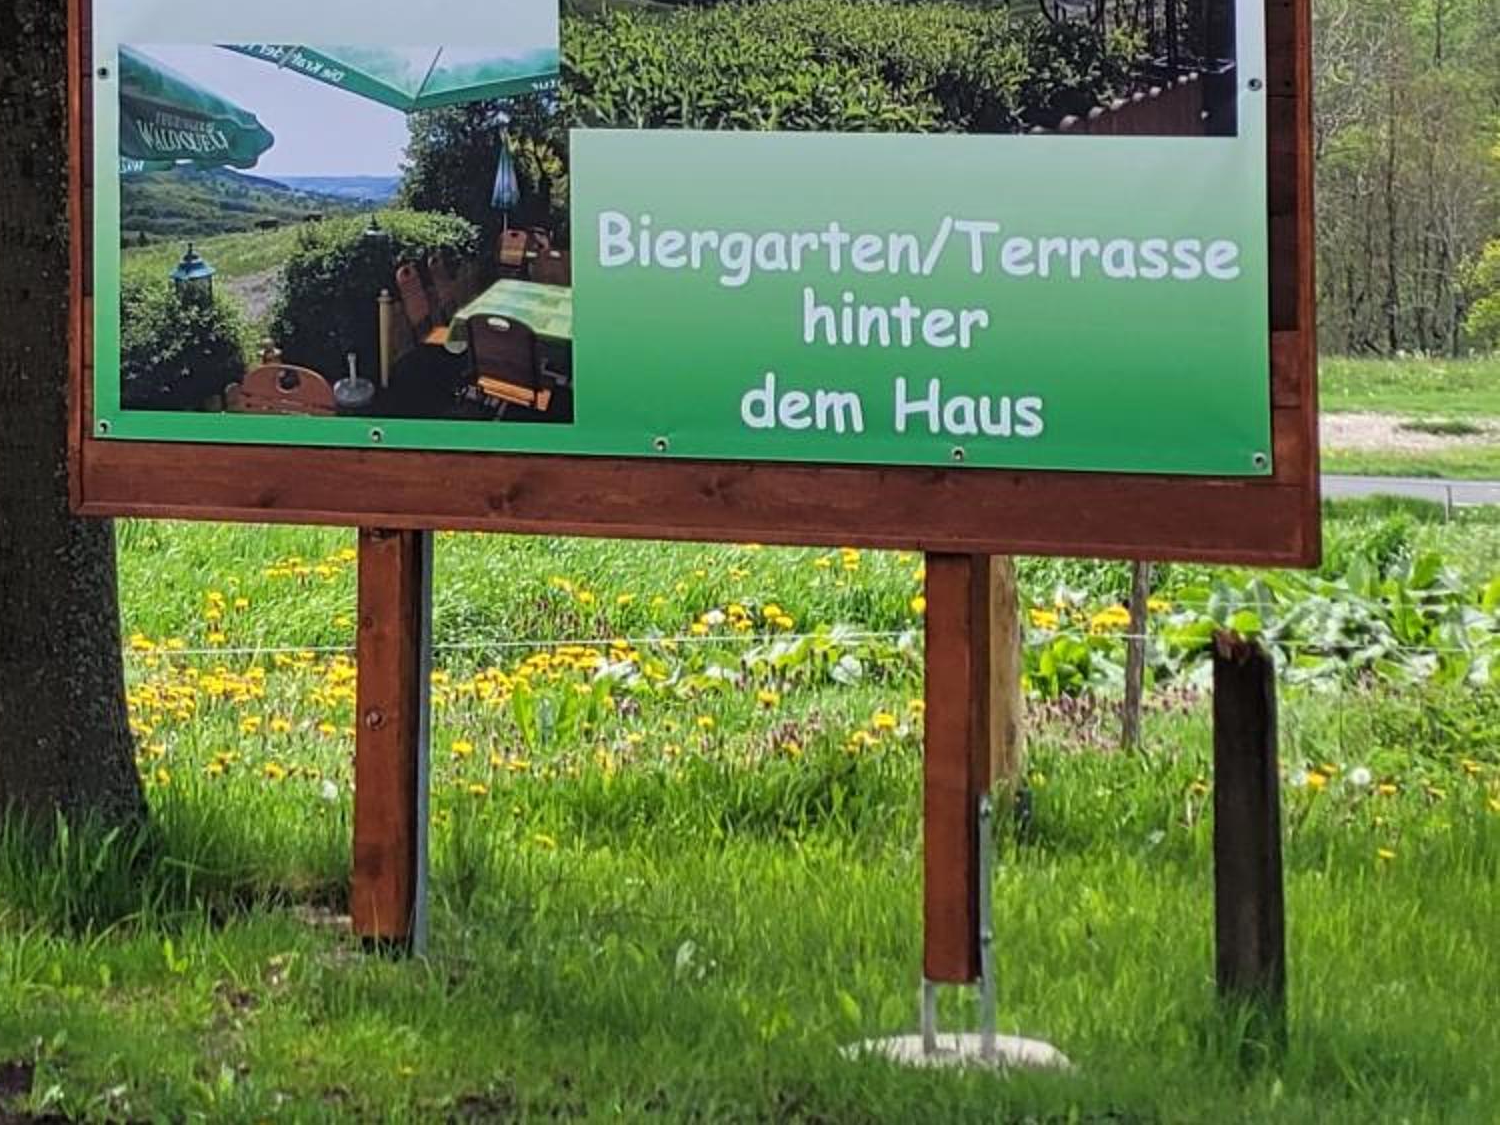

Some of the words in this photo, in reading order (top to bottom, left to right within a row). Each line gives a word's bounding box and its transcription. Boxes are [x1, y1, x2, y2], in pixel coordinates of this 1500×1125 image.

[597, 209, 1242, 287] Biergarten/Terrasse
[803, 288, 990, 349] hinter
[740, 372, 864, 433] dem
[894, 377, 1045, 437] Haus
